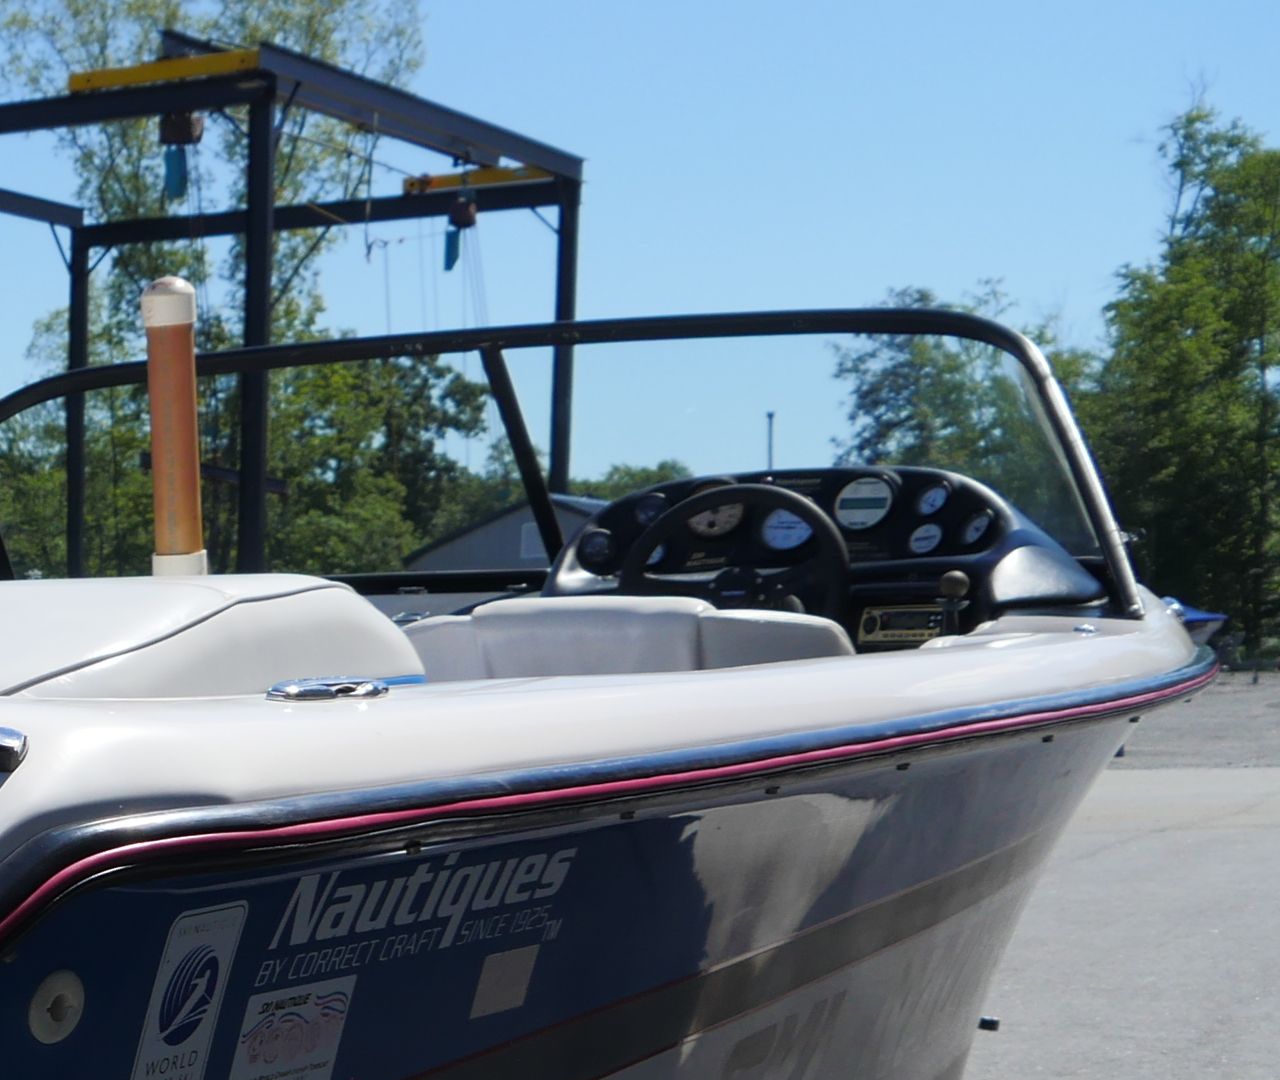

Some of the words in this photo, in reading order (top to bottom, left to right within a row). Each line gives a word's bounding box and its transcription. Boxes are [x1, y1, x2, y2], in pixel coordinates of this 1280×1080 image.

[268, 848, 578, 950] Nautiques
[254, 961, 285, 988] BY
[288, 939, 376, 980] CORRECT
[379, 927, 443, 961] CRAFT
[456, 914, 511, 945] SINCE
[510, 904, 553, 933] 1925
[144, 1050, 199, 1077] WORLD
